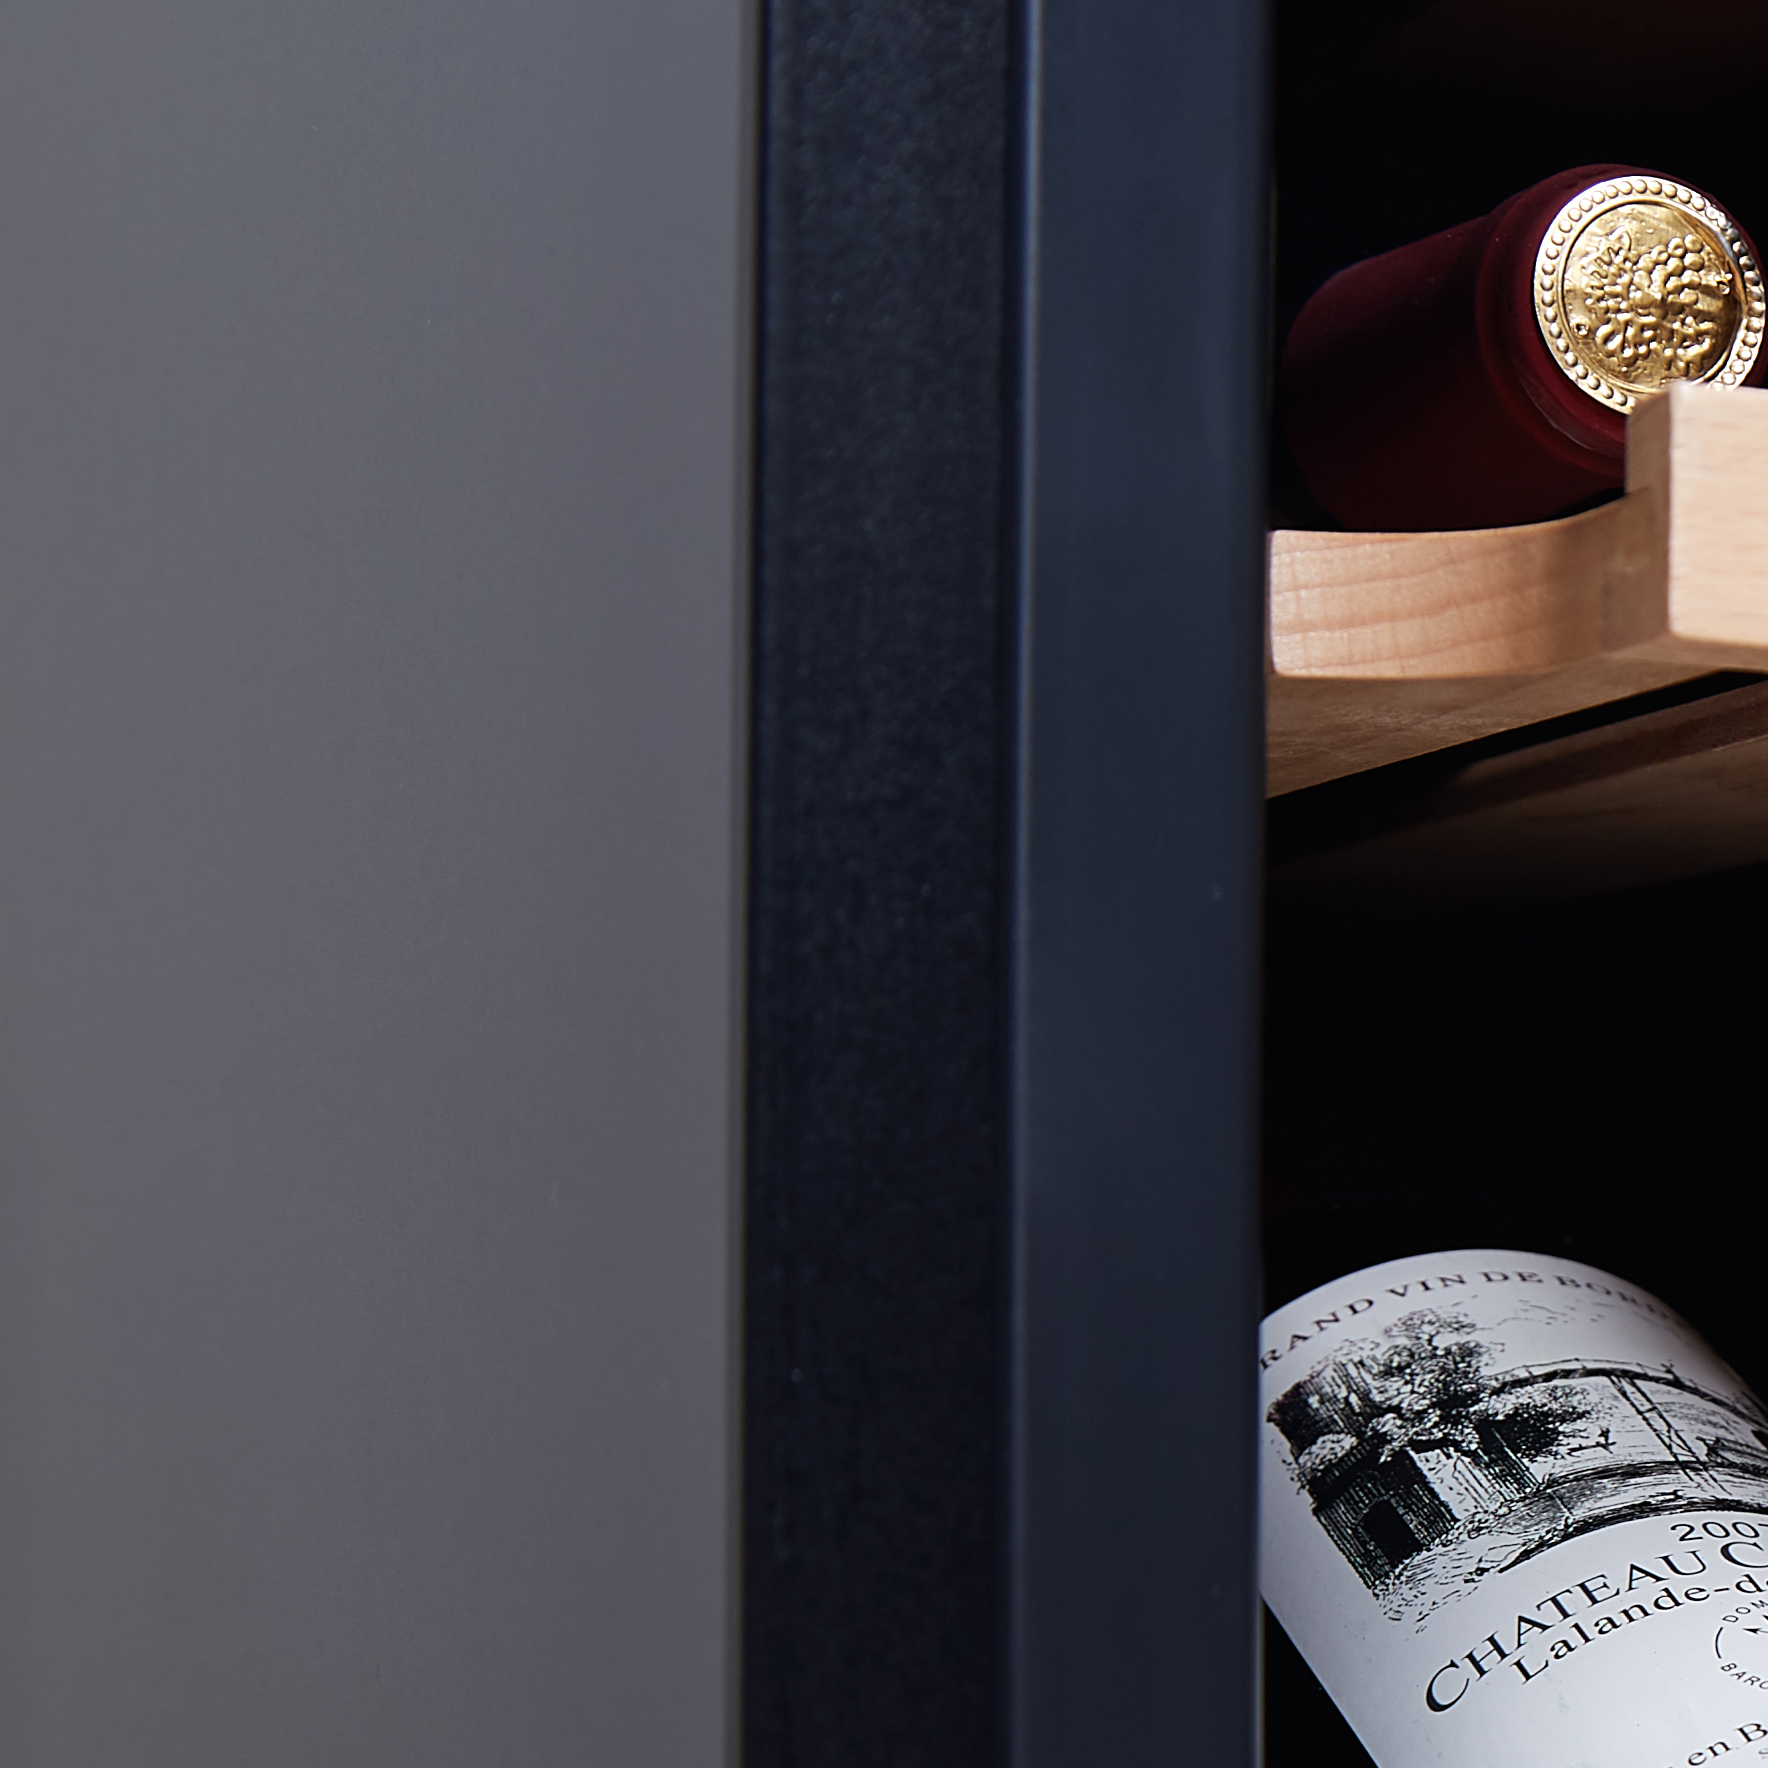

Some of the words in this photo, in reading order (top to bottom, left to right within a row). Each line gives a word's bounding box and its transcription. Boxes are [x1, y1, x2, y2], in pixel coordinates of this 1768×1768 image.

[1258, 1298, 1375, 1372] RAND
[1385, 1273, 1467, 1299] VIN
[1479, 1270, 1544, 1284] DE
[1425, 1549, 1707, 1713] CHATEAU
[1687, 1739, 1733, 1767] en
